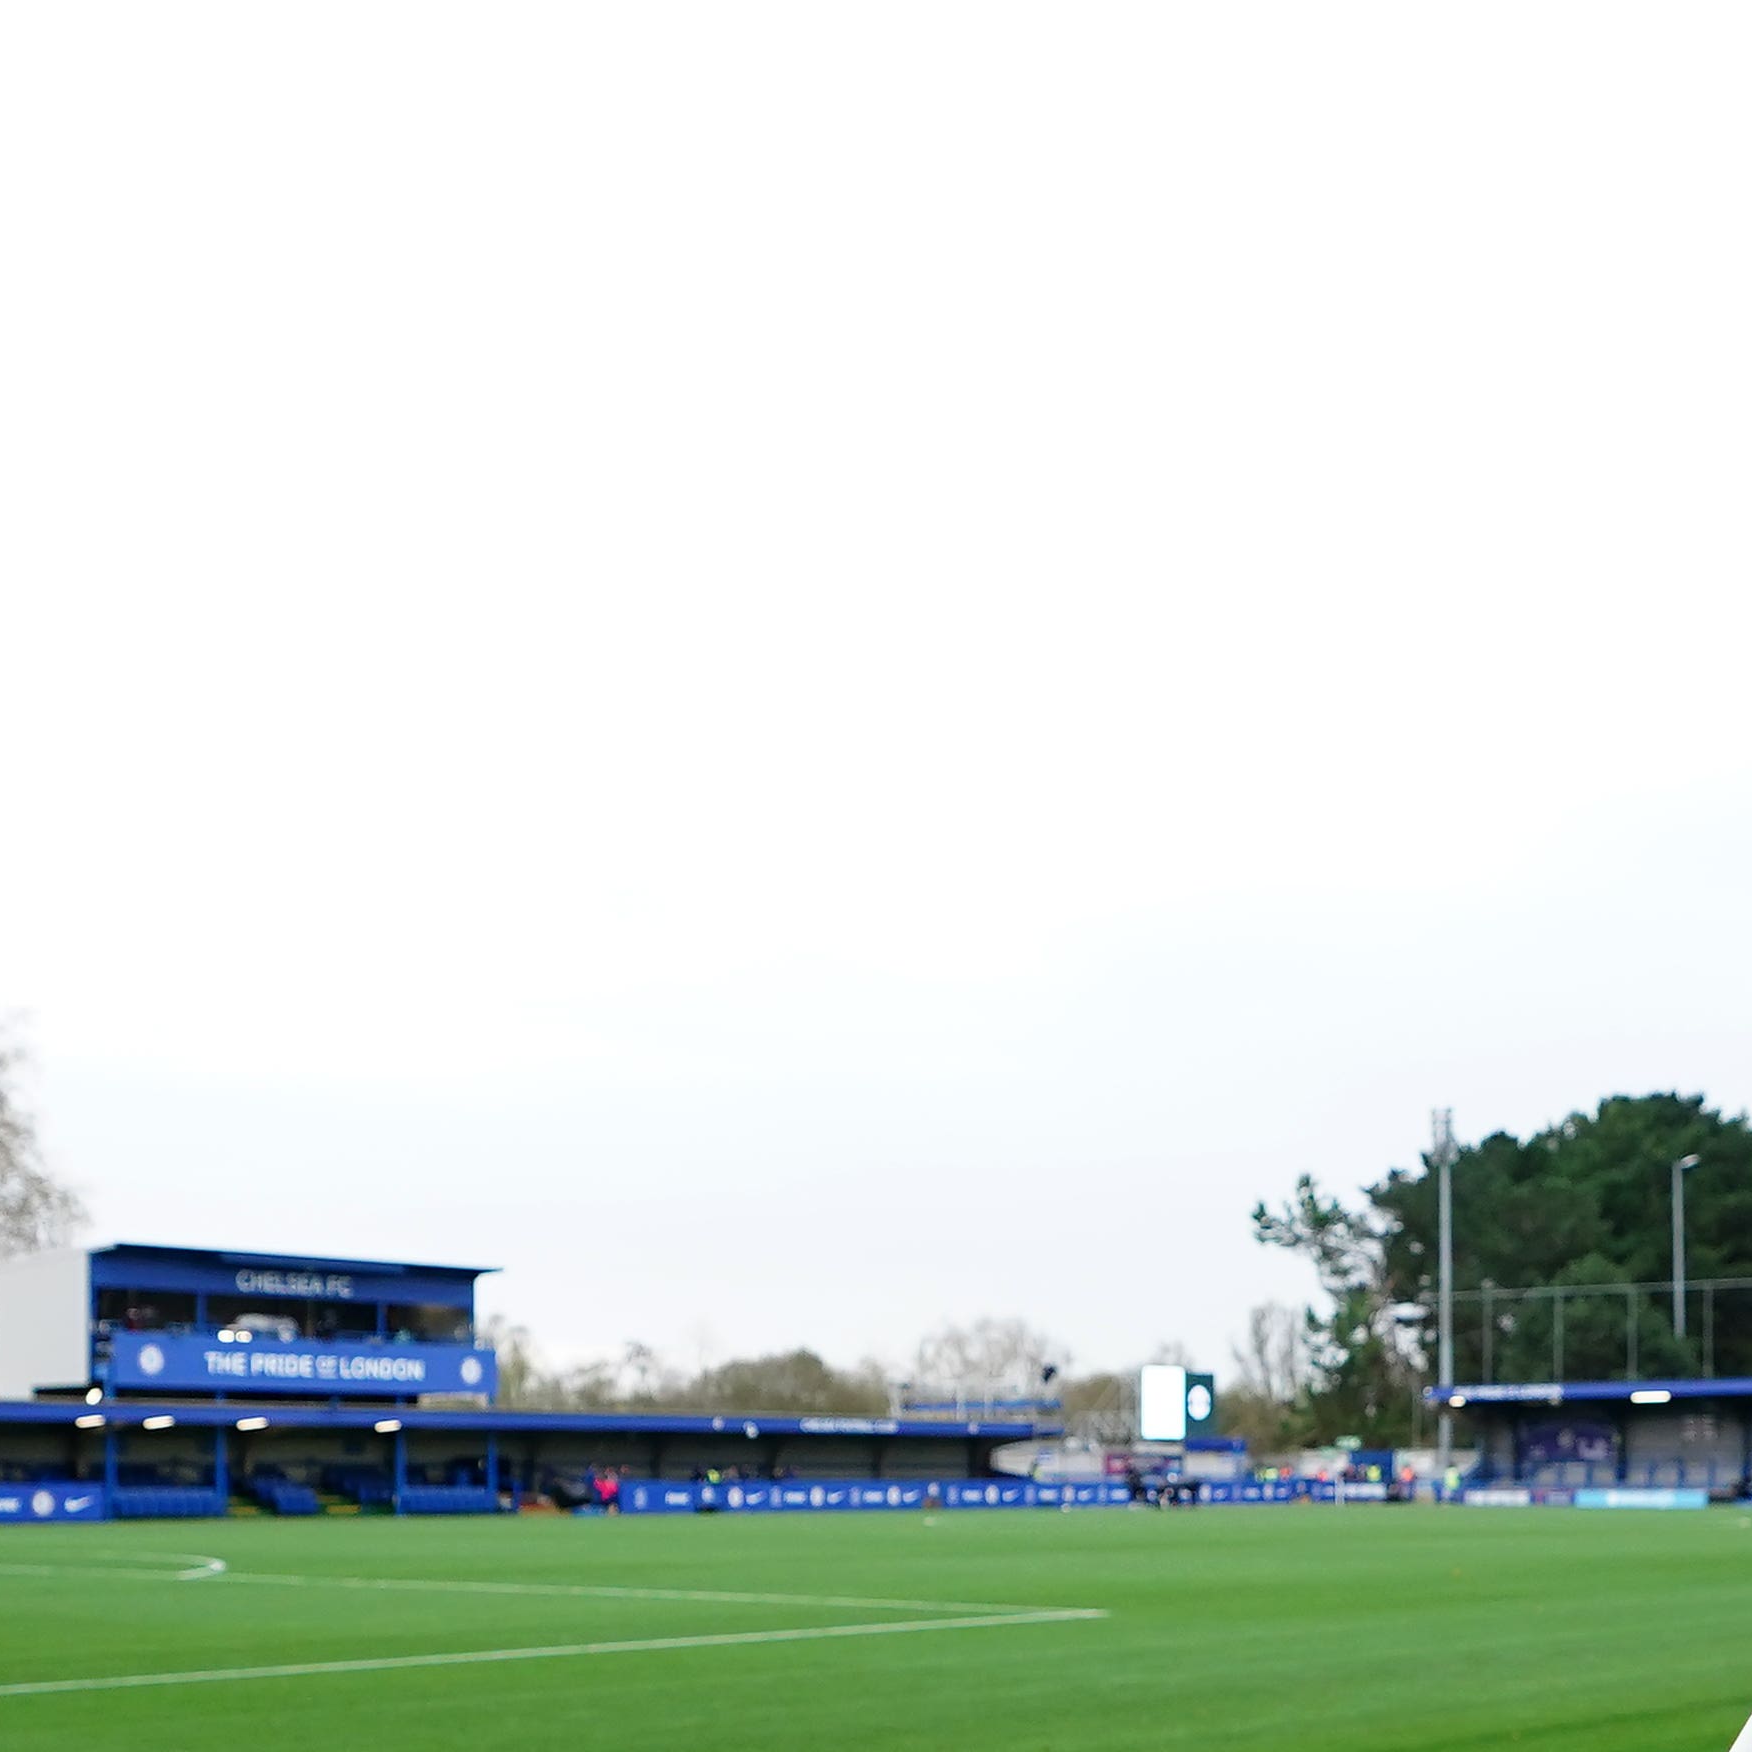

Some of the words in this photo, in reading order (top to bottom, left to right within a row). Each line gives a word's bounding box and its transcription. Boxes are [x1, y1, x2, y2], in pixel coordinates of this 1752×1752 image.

[235, 1269, 323, 1296] CHELSEA
[325, 1274, 354, 1299] FC
[204, 1351, 248, 1376] THE
[251, 1352, 314, 1378] PRIDE
[316, 1355, 338, 1379] OF
[339, 1356, 426, 1382] LONDON
